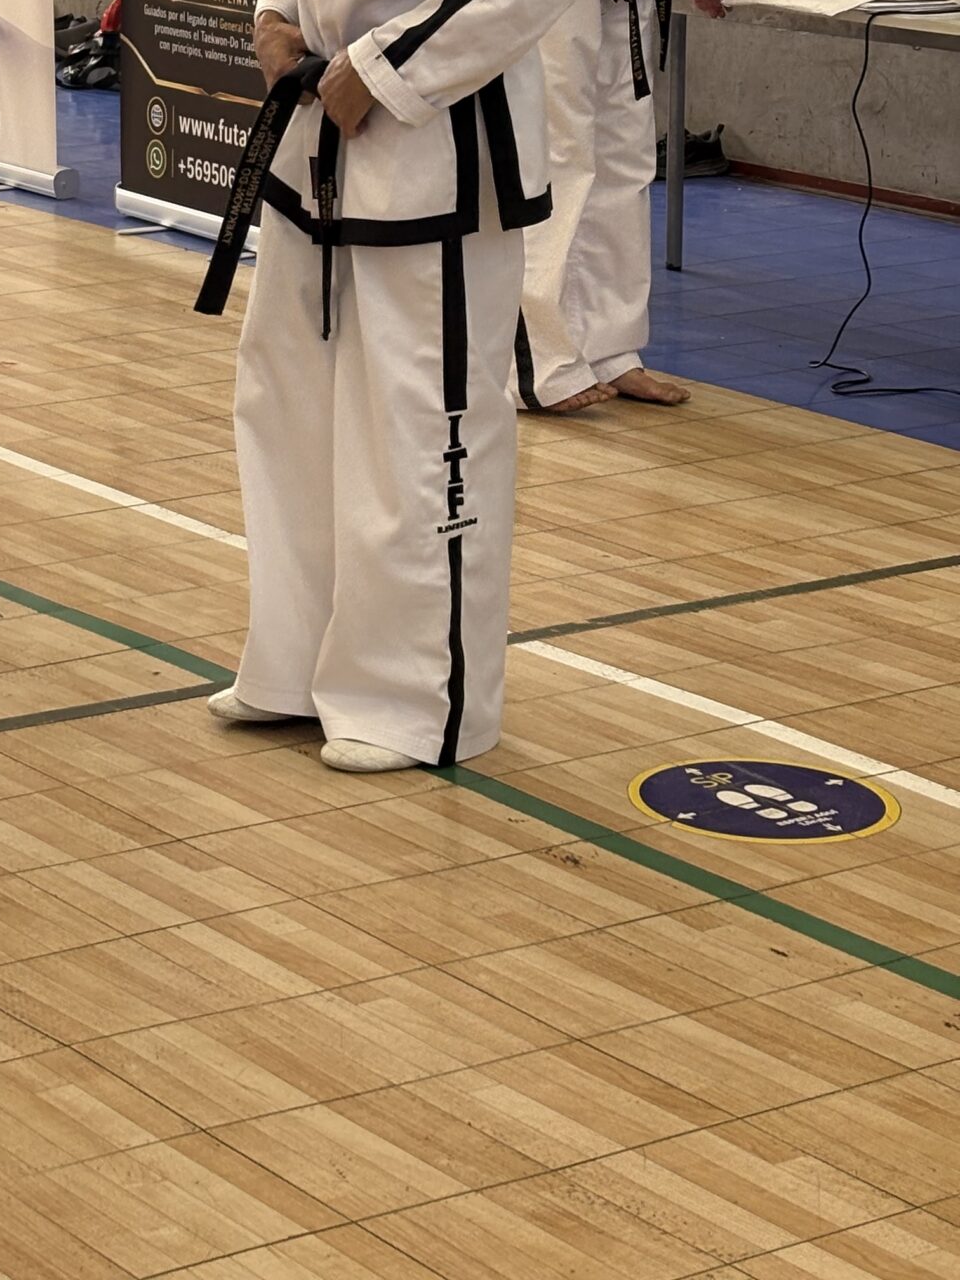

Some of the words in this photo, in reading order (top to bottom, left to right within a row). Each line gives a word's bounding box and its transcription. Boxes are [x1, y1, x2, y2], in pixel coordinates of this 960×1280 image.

[144, 4, 167, 19] Guiados
[168, 11, 178, 22] por
[180, 11, 186, 22] el
[187, 11, 207, 27] legado
[208, 16, 218, 29] del
[219, 17, 244, 33] General
[154, 24, 192, 40] promovemos
[193, 29, 200, 41] el
[201, 30, 239, 49] Taekwon-Do
[159, 41, 170, 51] con
[205, 49, 227, 62] valores
[228, 55, 233, 66] y
